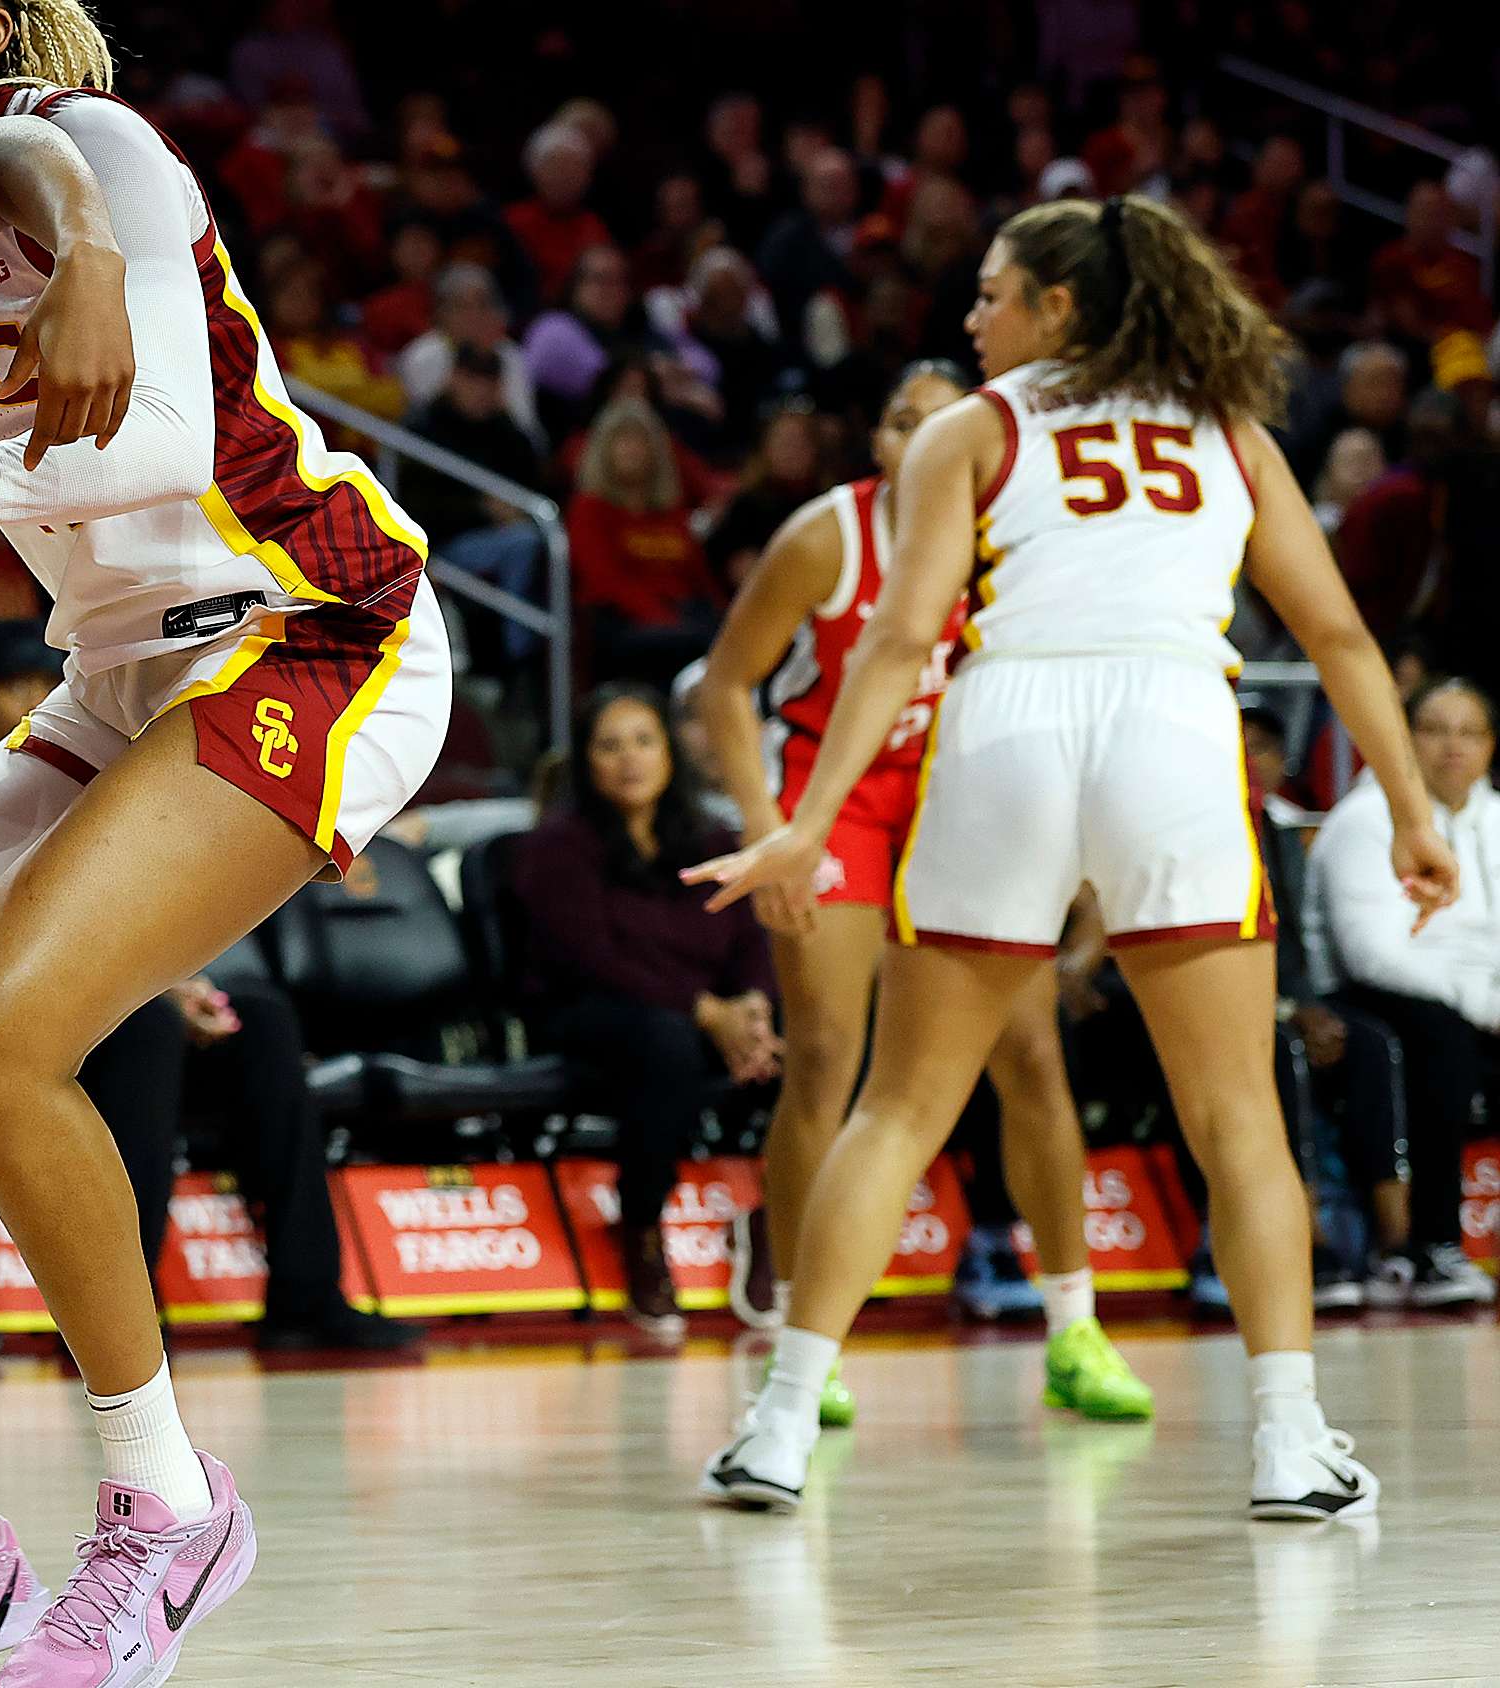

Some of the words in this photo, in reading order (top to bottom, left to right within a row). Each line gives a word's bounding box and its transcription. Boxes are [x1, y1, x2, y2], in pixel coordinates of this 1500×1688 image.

[1052, 421, 1203, 517] 55
[378, 1184, 528, 1228] WELLS
[396, 1227, 540, 1273] FARGO
